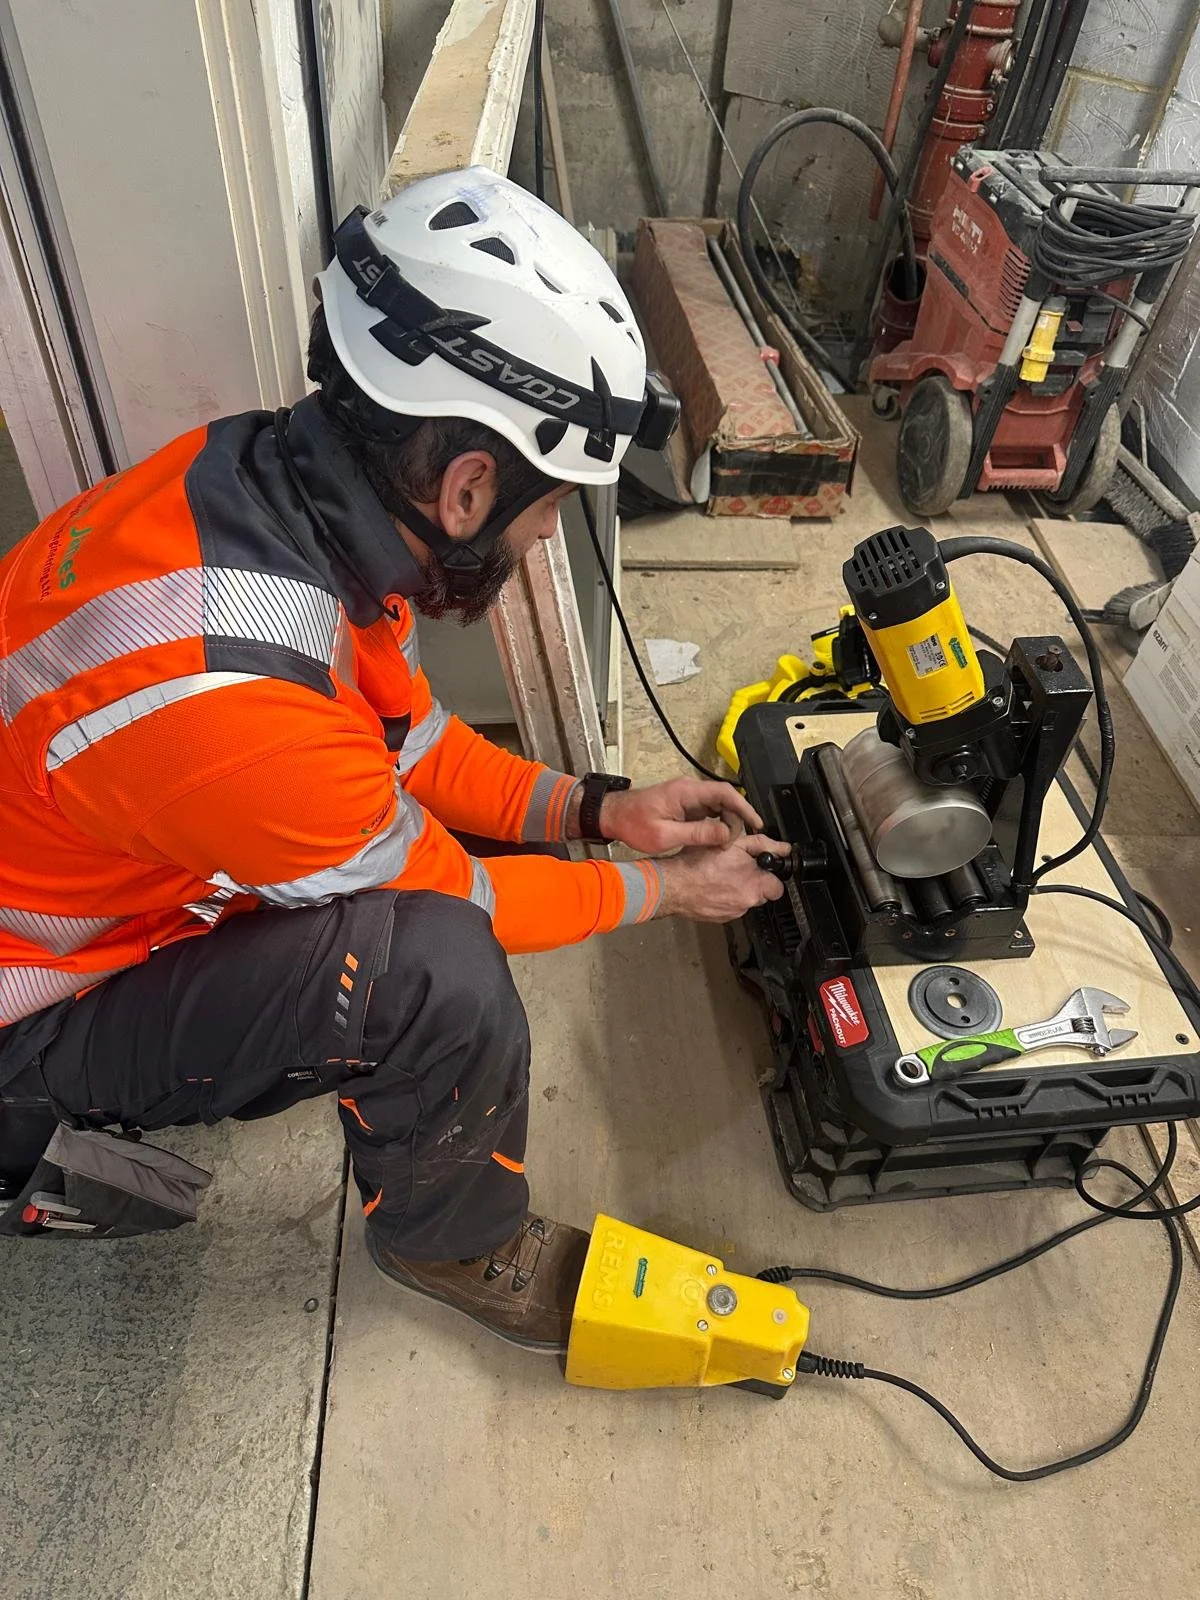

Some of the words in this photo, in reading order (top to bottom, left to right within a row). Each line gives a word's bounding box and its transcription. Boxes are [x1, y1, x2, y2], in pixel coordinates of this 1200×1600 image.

[428, 334, 581, 410] COAST
[828, 981, 860, 1026] Milwaukee
[830, 1008, 847, 1044] PACKOUT
[592, 1229, 626, 1311] REMS
